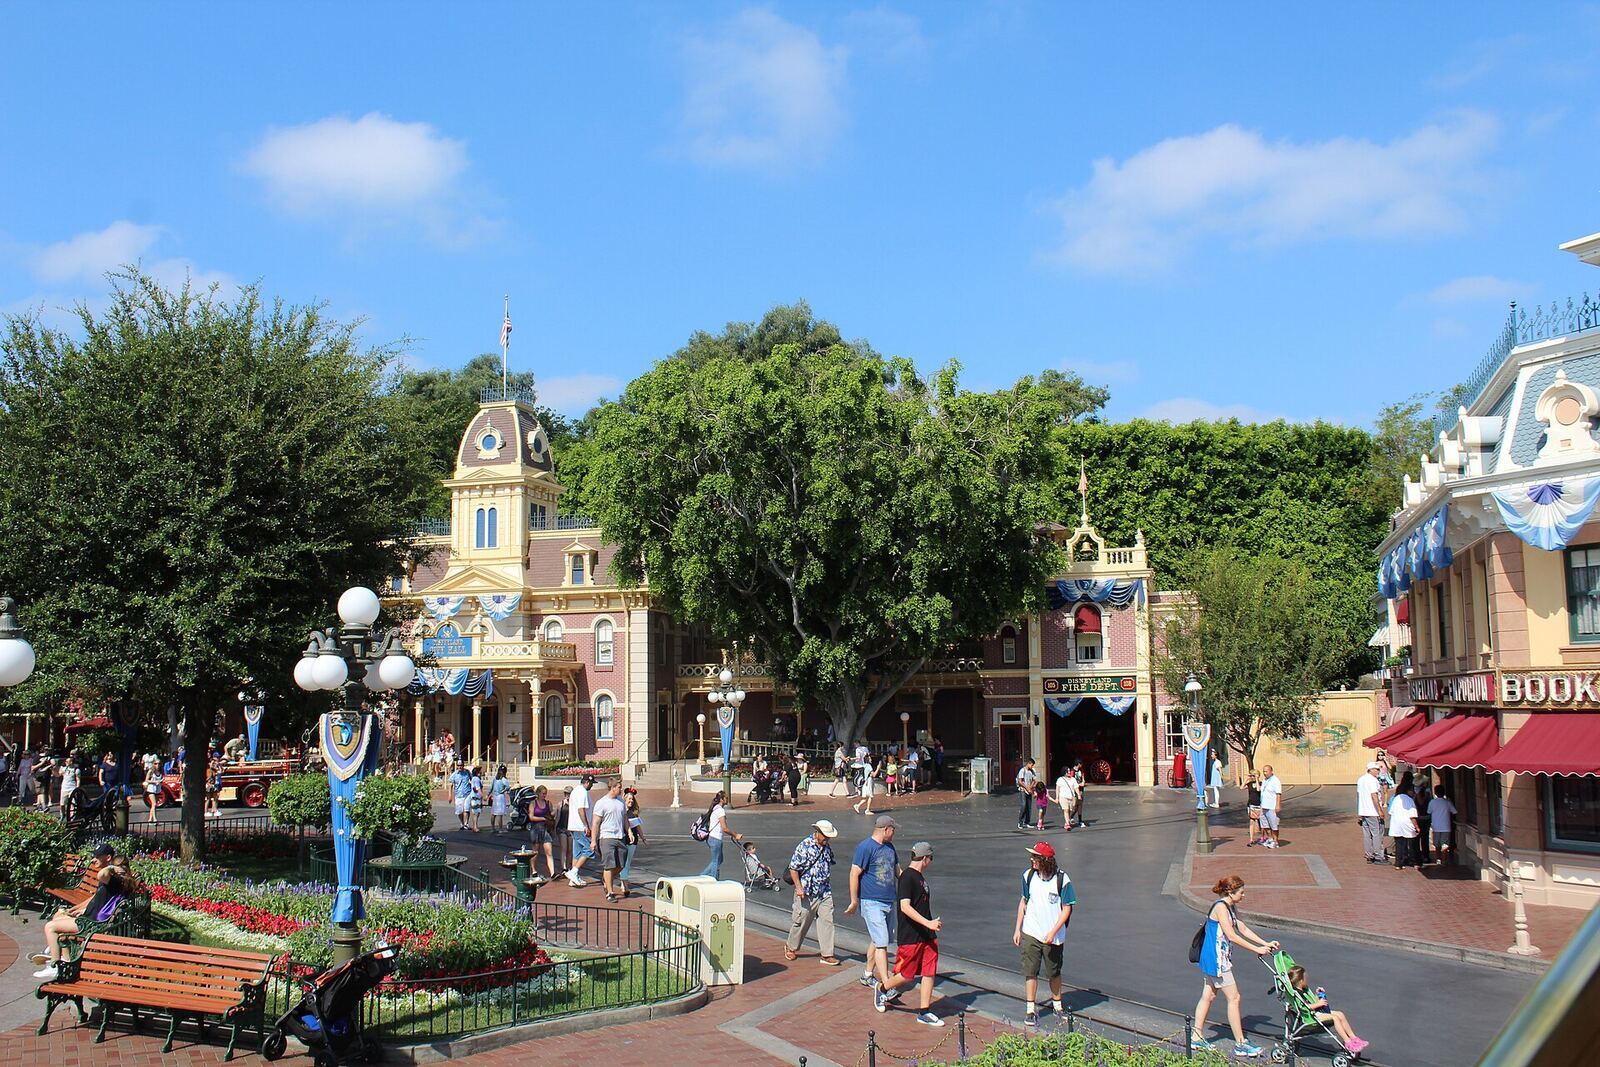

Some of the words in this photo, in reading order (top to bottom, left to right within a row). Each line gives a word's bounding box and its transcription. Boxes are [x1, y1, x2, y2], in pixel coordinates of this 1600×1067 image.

[1061, 683, 1087, 692] FIRE
[1089, 682, 1119, 691] DEPT.
[1449, 675, 1488, 702] EMPORIUM
